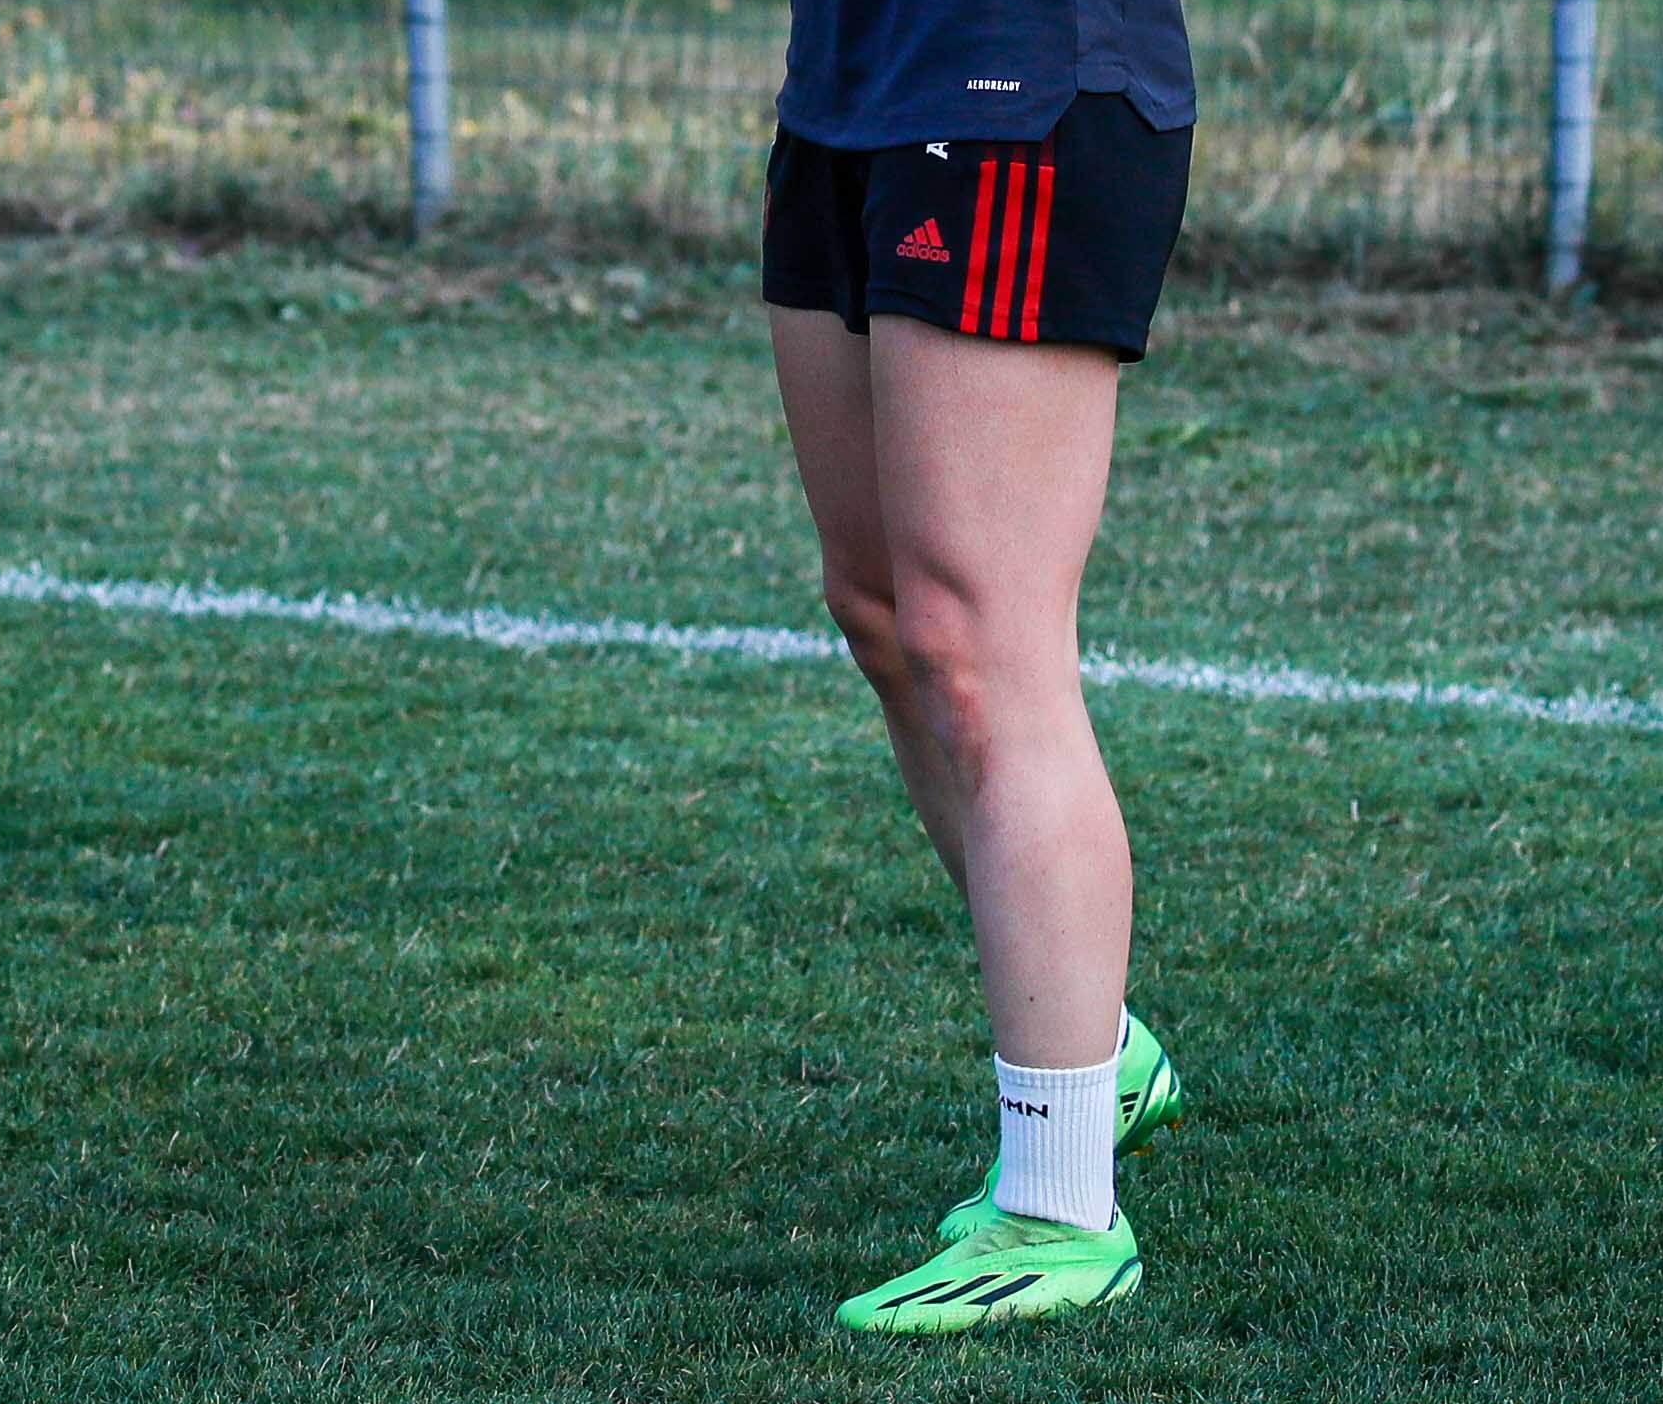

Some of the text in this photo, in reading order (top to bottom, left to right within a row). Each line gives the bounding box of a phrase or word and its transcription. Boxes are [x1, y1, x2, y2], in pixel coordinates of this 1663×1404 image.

[966, 79, 1021, 92] AEROREADY
[926, 141, 950, 160] A
[896, 243, 950, 263] adidas
